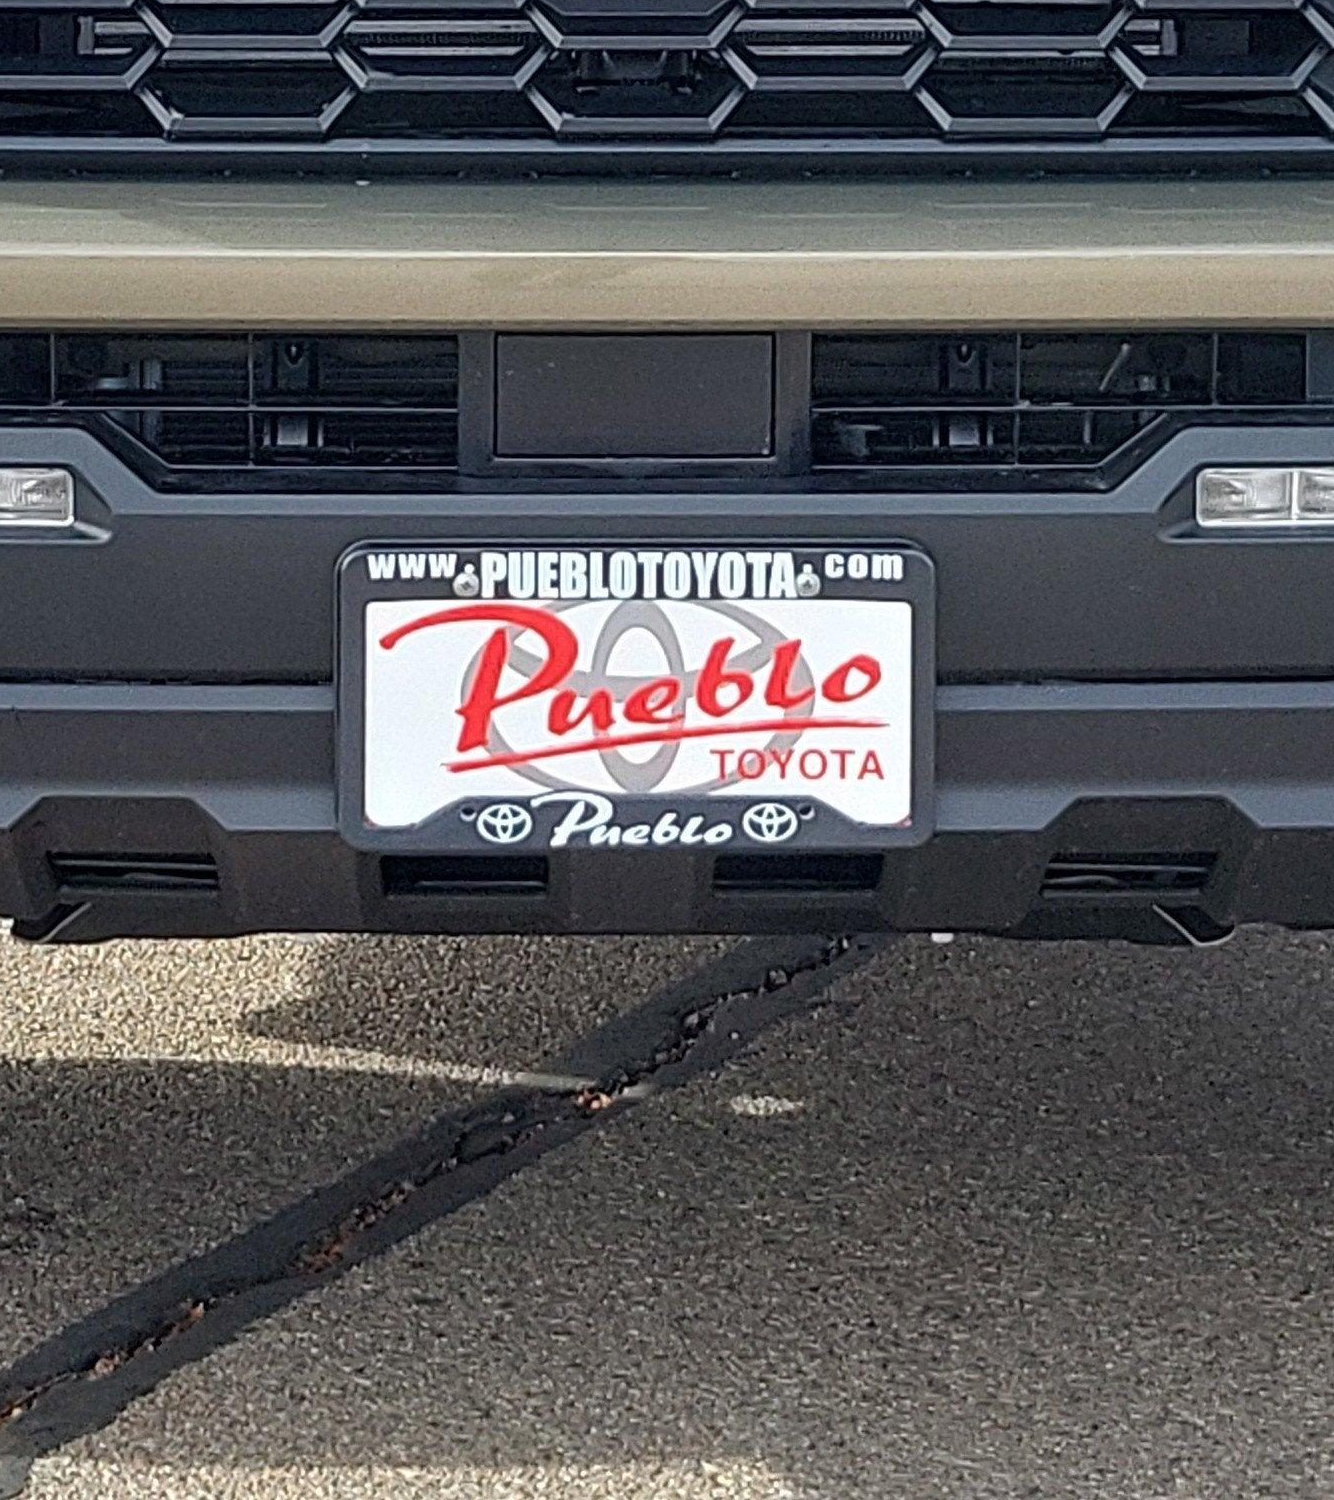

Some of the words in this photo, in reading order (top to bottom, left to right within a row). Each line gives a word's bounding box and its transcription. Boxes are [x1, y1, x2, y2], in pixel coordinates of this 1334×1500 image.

[379, 603, 883, 753] Pueblo
[710, 748, 885, 781] TOYOTA
[531, 790, 734, 849] Pueblo
